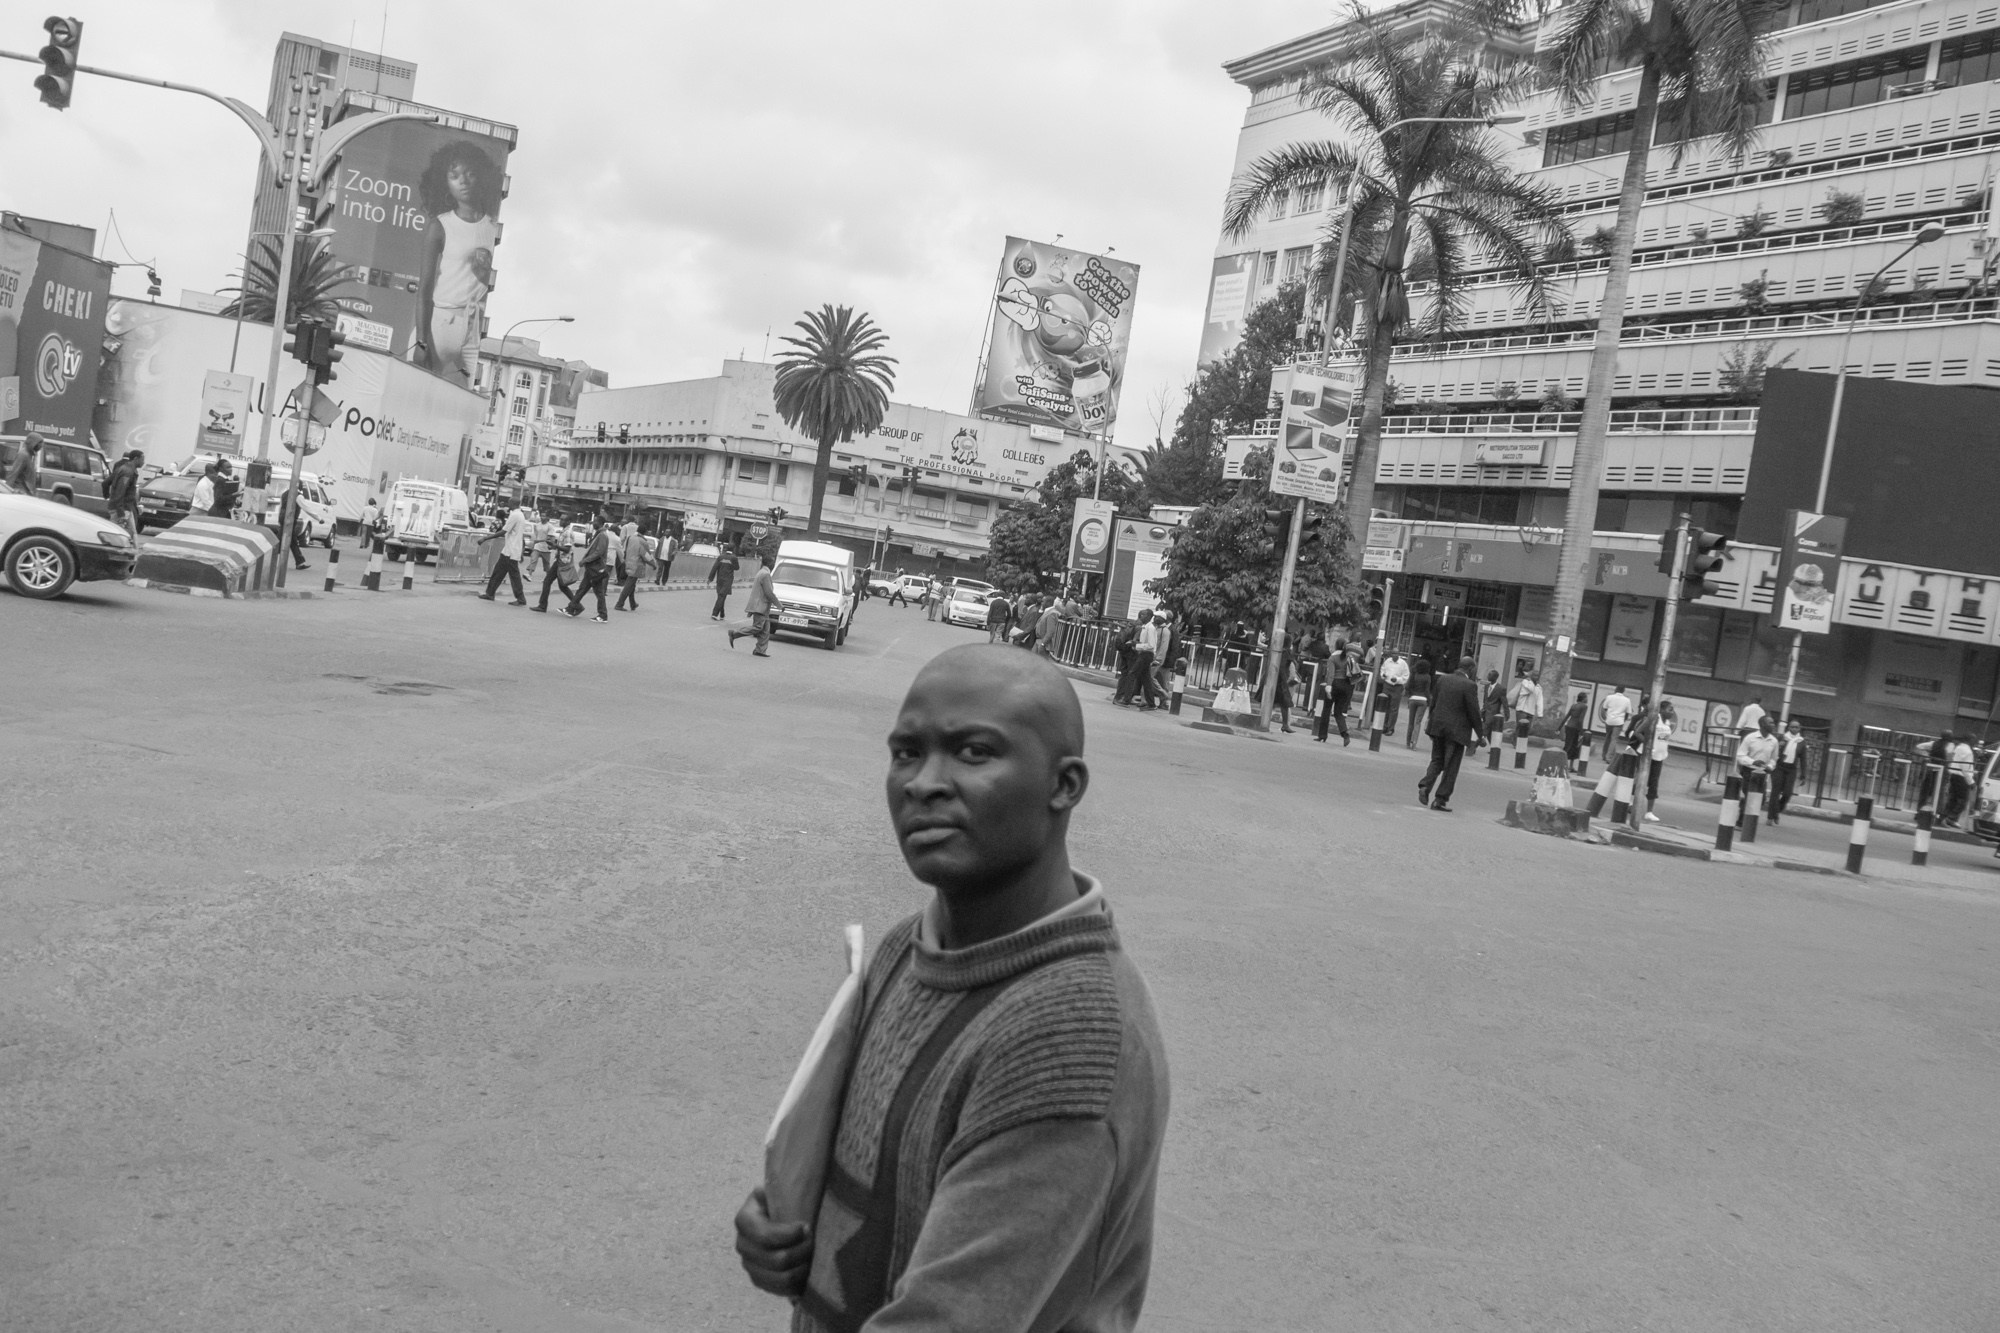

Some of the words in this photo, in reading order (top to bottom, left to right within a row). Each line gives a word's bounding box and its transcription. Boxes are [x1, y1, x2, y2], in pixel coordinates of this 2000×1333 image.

[345, 168, 411, 202] Zoom
[343, 194, 386, 223] into
[392, 204, 426, 231] life
[1082, 269, 1122, 304] power
[1088, 258, 1111, 281] Get
[1109, 277, 1130, 300] the
[42, 280, 93, 320] CHEKI
[1074, 273, 1088, 290] to
[1088, 287, 1119, 317] clean
[352, 301, 373, 313] can
[1016, 376, 1034, 385] with
[1019, 384, 1070, 402] SafiSana-
[1027, 396, 1075, 414] Catalysts
[879, 425, 908, 440] GROUP
[910, 431, 924, 442] OF
[1002, 448, 1045, 466] COLLEGES
[900, 454, 914, 465] THE
[919, 458, 984, 478] PROFESSIONAL
[989, 472, 1021, 484] PEOPLE
[752, 525, 767, 535] STOP
[1681, 718, 1698, 734] LG
